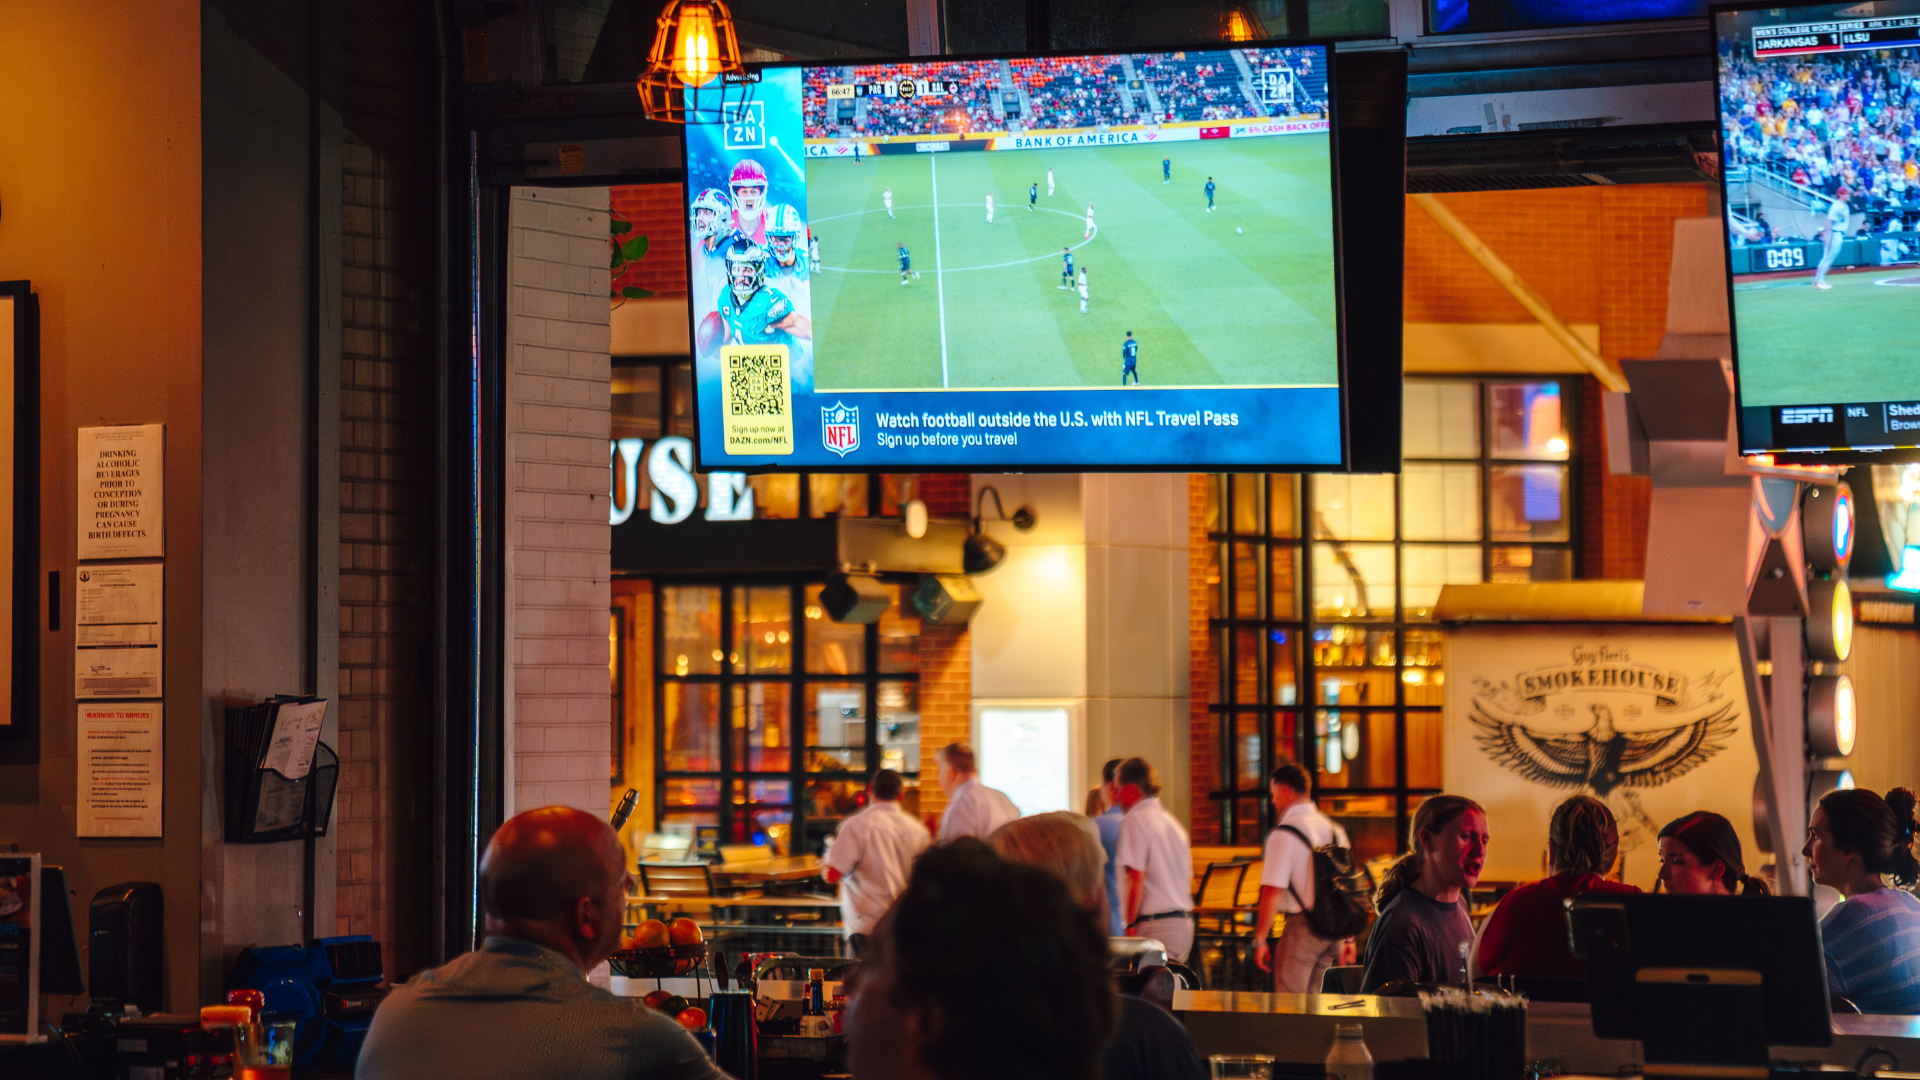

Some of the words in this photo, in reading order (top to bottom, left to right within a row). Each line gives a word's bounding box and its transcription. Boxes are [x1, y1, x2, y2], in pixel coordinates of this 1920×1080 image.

[1778, 26, 1810, 34] COLLEGE
[1839, 22, 1864, 30] SERIES
[1830, 34, 1838, 44] 1
[831, 87, 850, 96] 66:47
[932, 82, 944, 92] SAL
[1262, 124, 1284, 133] CASH
[1286, 122, 1307, 131] BACK
[1016, 136, 1052, 148] BANK
[1056, 136, 1073, 146] OF
[1077, 132, 1138, 144] AMERICA
[1766, 248, 1804, 268] 0:09
[876, 412, 919, 428] Watch
[922, 412, 975, 428] football
[978, 411, 1030, 428] outside
[1034, 411, 1057, 427] the
[1060, 411, 1088, 427] U.S.
[1091, 410, 1122, 427] with
[1125, 410, 1154, 426] NFL
[1156, 410, 1200, 426] Travel
[1204, 410, 1239, 426] Pass
[1781, 406, 1834, 424] ESPN
[1848, 408, 1869, 418] NFL
[732, 425, 748, 434] Sign
[730, 436, 788, 444] DAZN.com/NFL
[827, 425, 855, 448] NFL
[877, 432, 902, 448] Sign
[905, 435, 919, 448] up
[922, 432, 958, 446] before
[961, 434, 982, 448] you
[984, 432, 1017, 445] travel
[100, 450, 136, 458] DRINKING
[96, 460, 140, 468] ALCOHOLIC
[96, 470, 140, 478] BEVERAGES
[94, 490, 142, 498] CONCEPTION
[1523, 668, 1680, 695] SMOKEHOUSE
